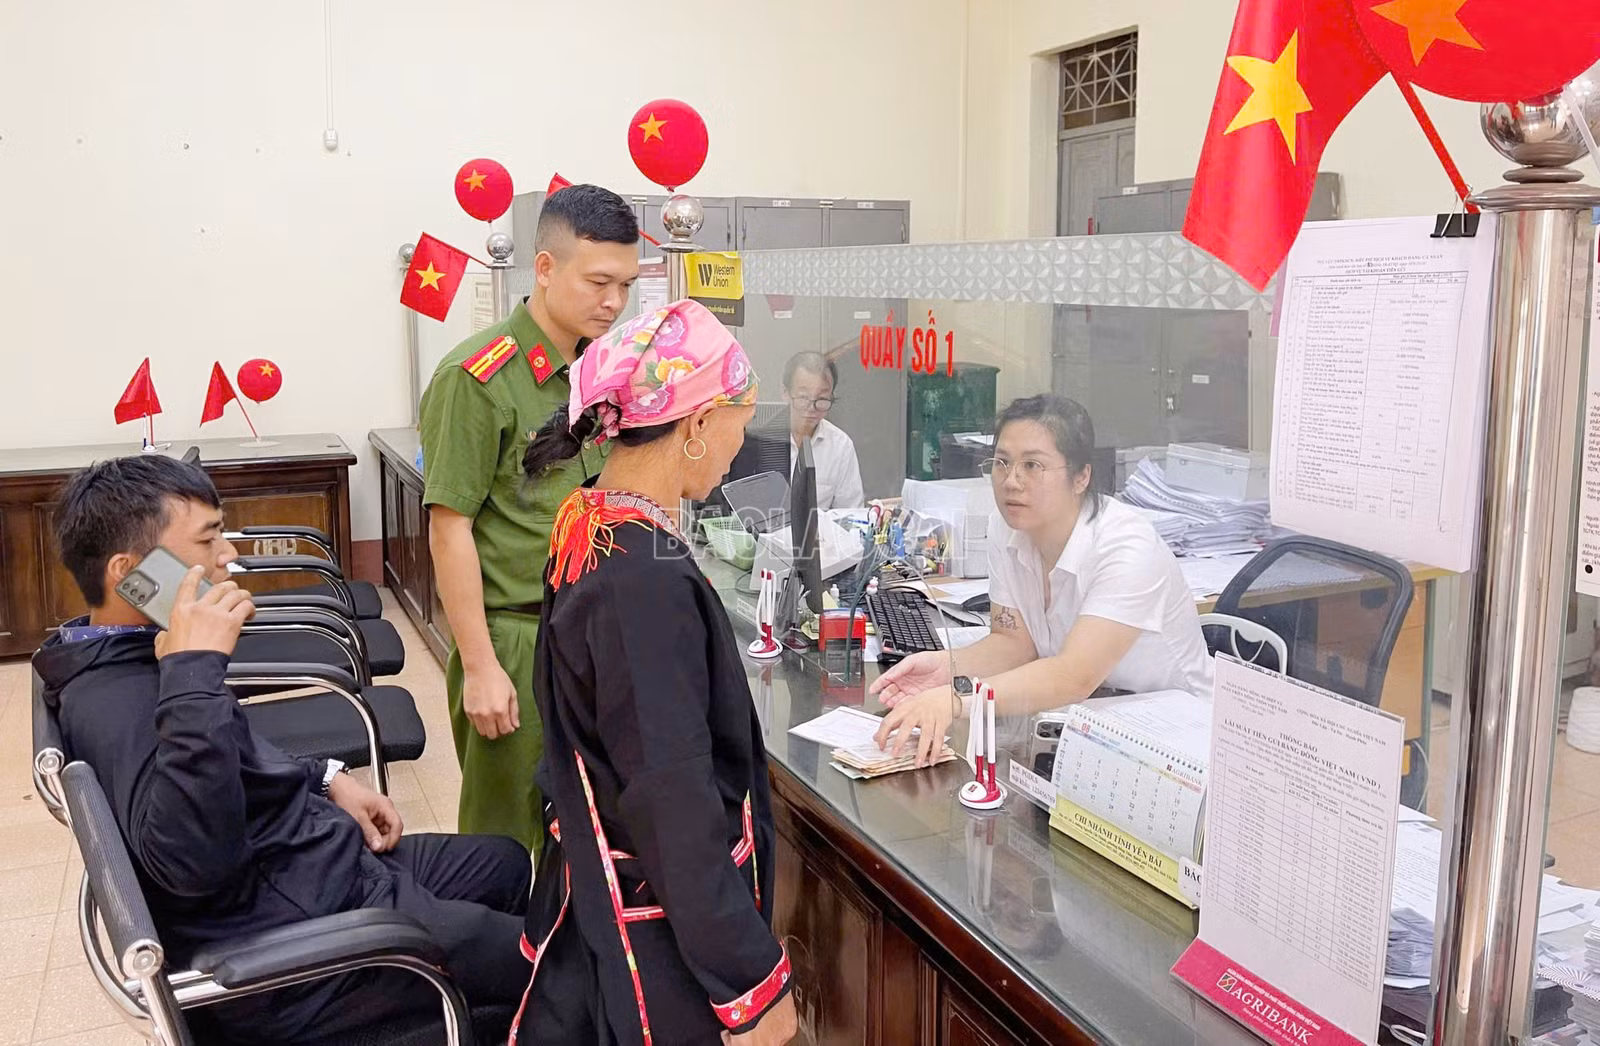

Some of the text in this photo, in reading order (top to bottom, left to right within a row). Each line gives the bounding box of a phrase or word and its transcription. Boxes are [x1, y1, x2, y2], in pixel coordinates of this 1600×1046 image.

[713, 263, 735, 276] Western
[713, 276, 729, 288] Union
[911, 309, 937, 374] SỐ
[945, 329, 953, 377] 1
[1172, 768, 1202, 786] AGRIBANK
[1339, 765, 1356, 778] NAM
[1074, 812, 1087, 826] CHI
[1087, 819, 1112, 839] NHÁNH
[1113, 831, 1131, 849] TỈNH
[1132, 843, 1147, 859] YÊN
[1148, 853, 1163, 868] BÁI
[1230, 986, 1313, 1045] AGRIBANK
